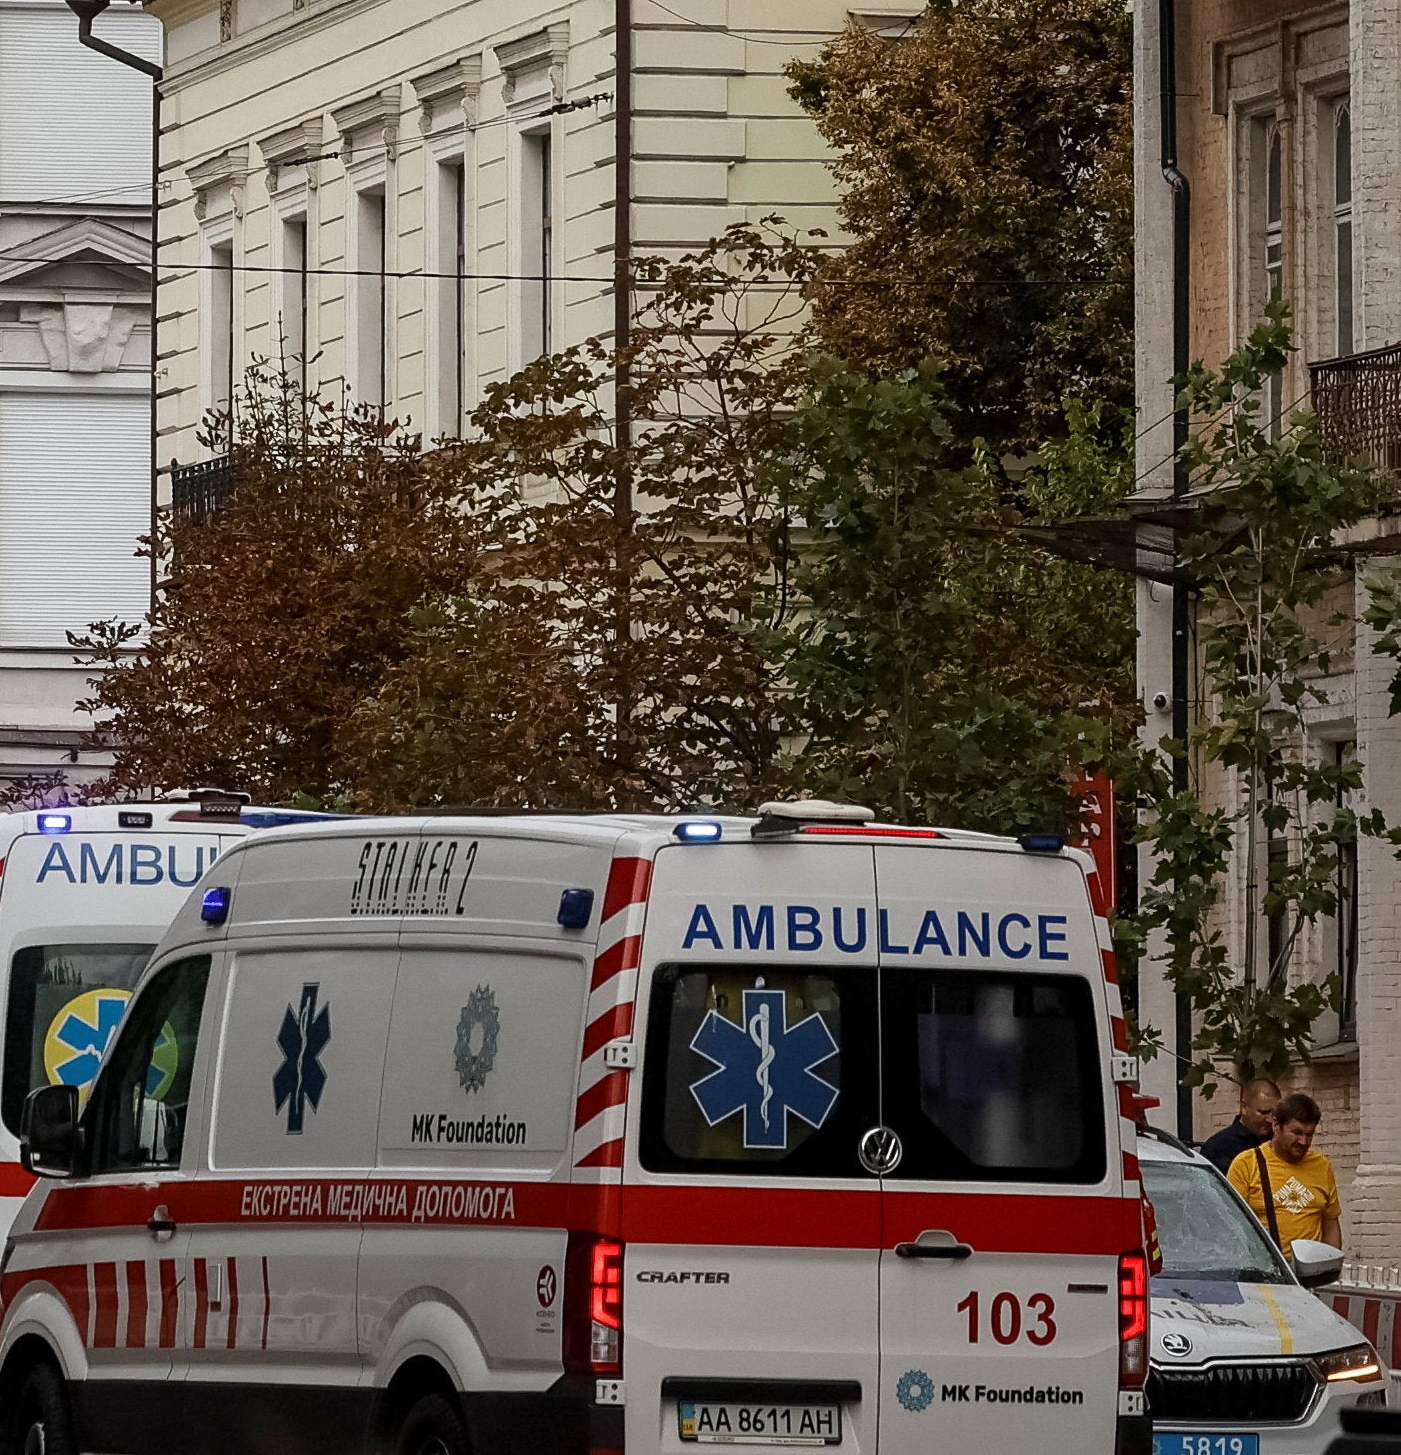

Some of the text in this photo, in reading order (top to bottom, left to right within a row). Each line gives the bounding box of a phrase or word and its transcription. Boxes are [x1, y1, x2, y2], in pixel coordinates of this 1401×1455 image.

[456, 841, 478, 915] 2
[682, 904, 1069, 961] AMBULANCE
[411, 1114, 526, 1144] MK Foundation
[241, 1185, 515, 1222] ЕКСТРЕНА МЕДИЧНА ДОПОМОГА
[636, 1271, 730, 1284] CRAFTER
[957, 1290, 1057, 1346] 103
[941, 1384, 1084, 1405] MK Foundation
[738, 1408, 791, 1433] 8611
[1182, 1436, 1243, 1455] 5819
